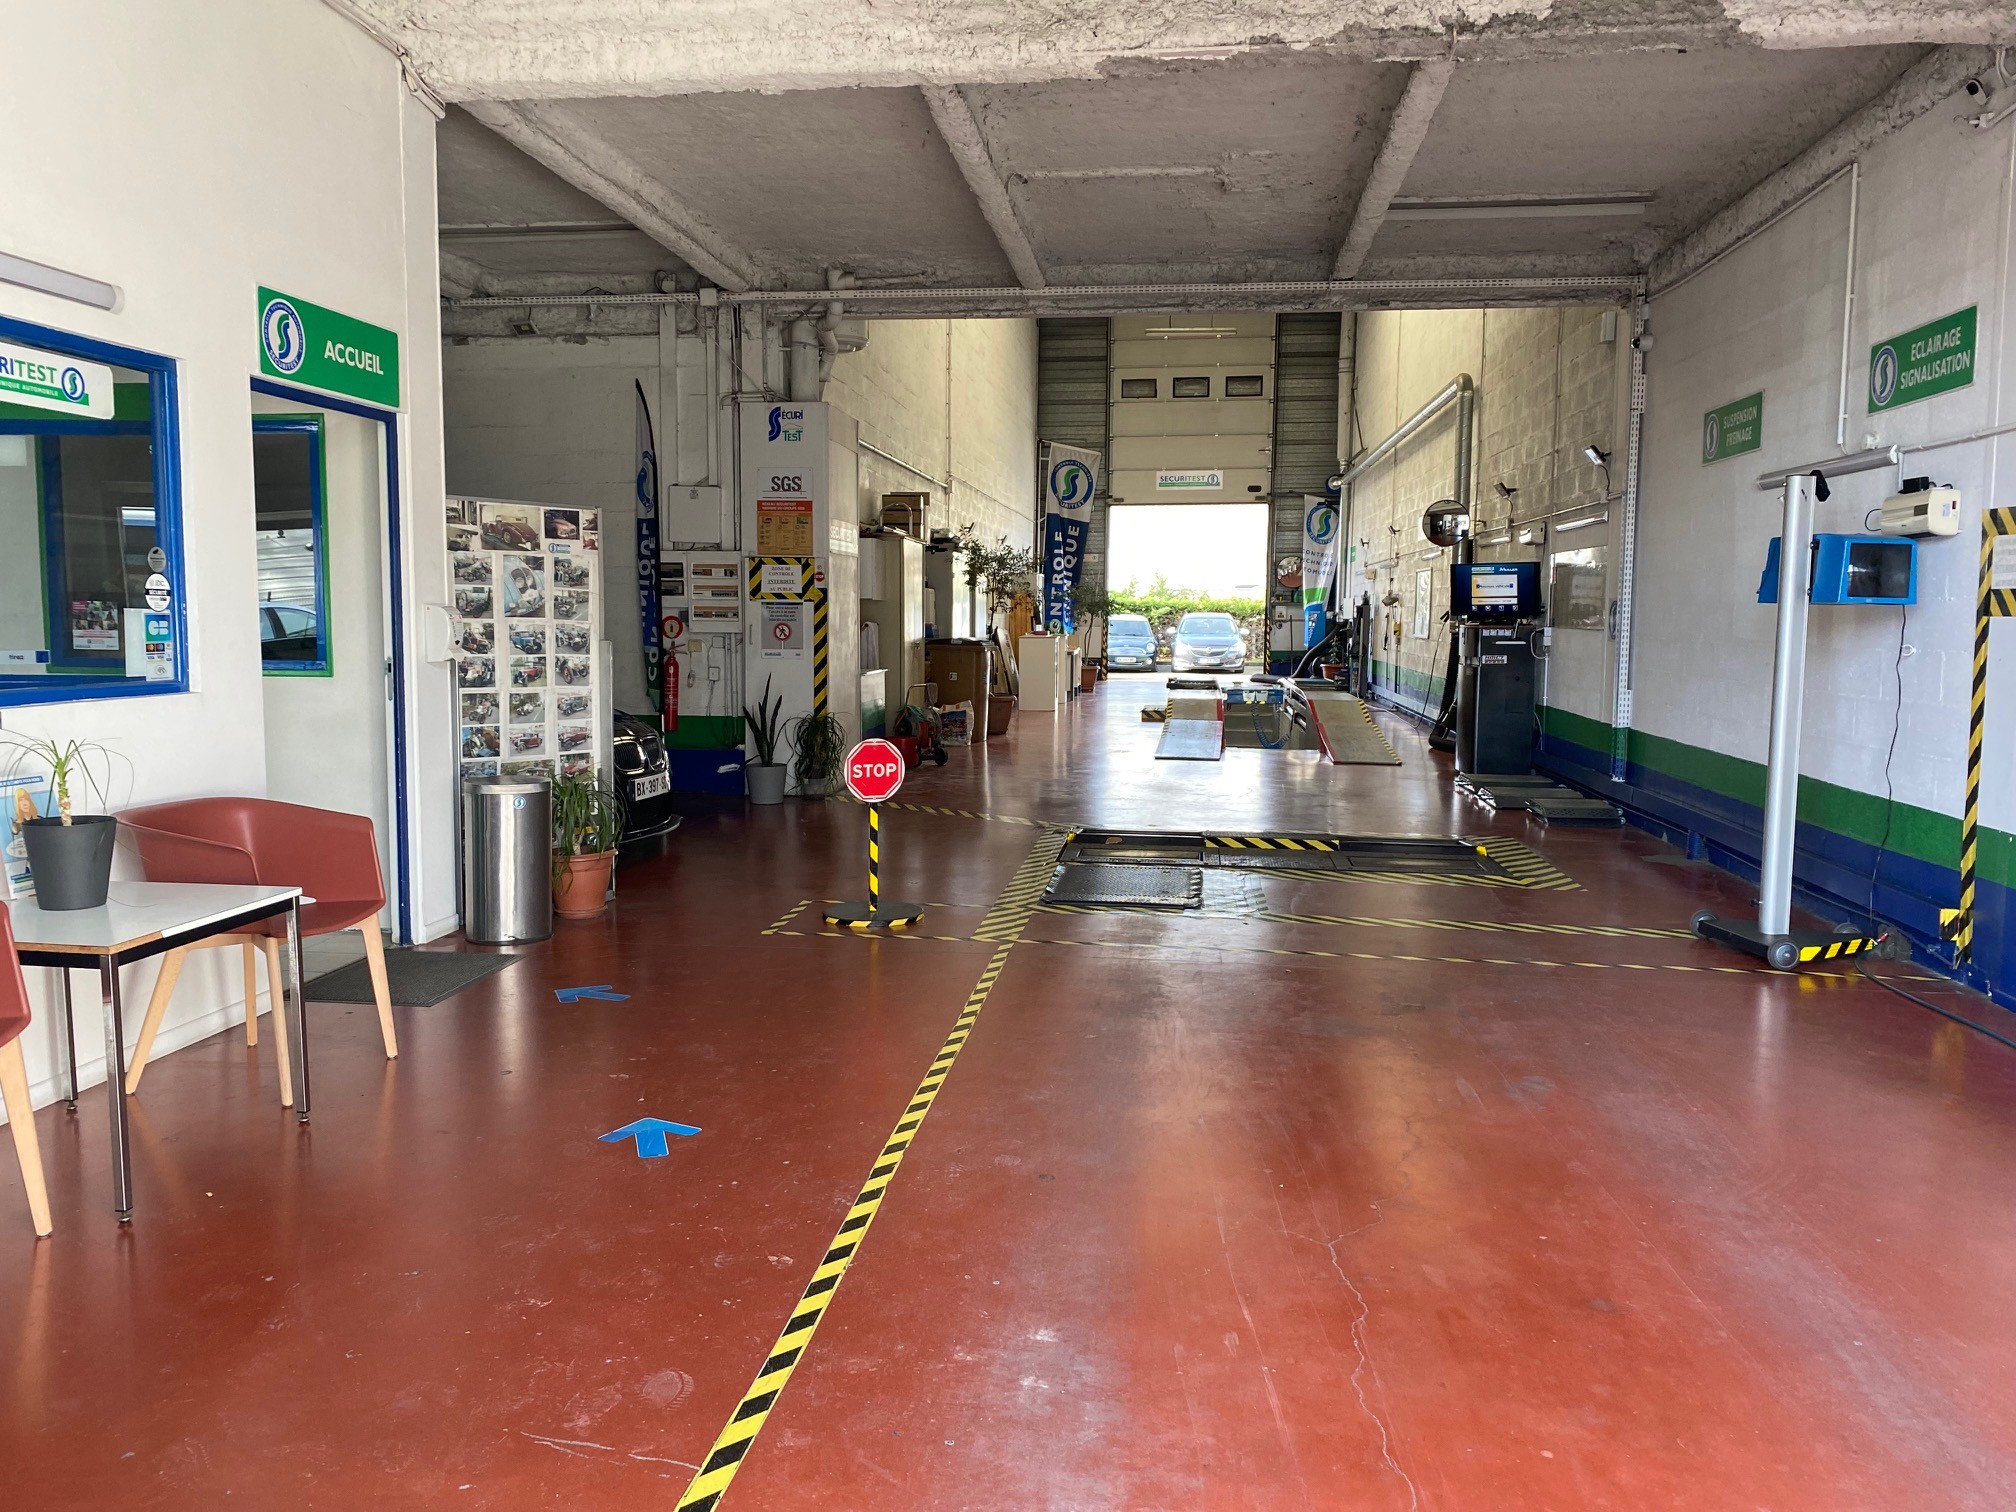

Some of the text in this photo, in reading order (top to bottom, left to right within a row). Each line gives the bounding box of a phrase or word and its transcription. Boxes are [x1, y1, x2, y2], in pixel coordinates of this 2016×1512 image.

[323, 339, 385, 376] ACCUEIL
[1910, 325, 1962, 361] ECLAIRAGE
[1900, 349, 1971, 390] SIGNALISATION
[1723, 404, 1758, 430] SUSPENSION
[771, 475, 802, 492] SGS
[852, 763, 897, 779] STOP
